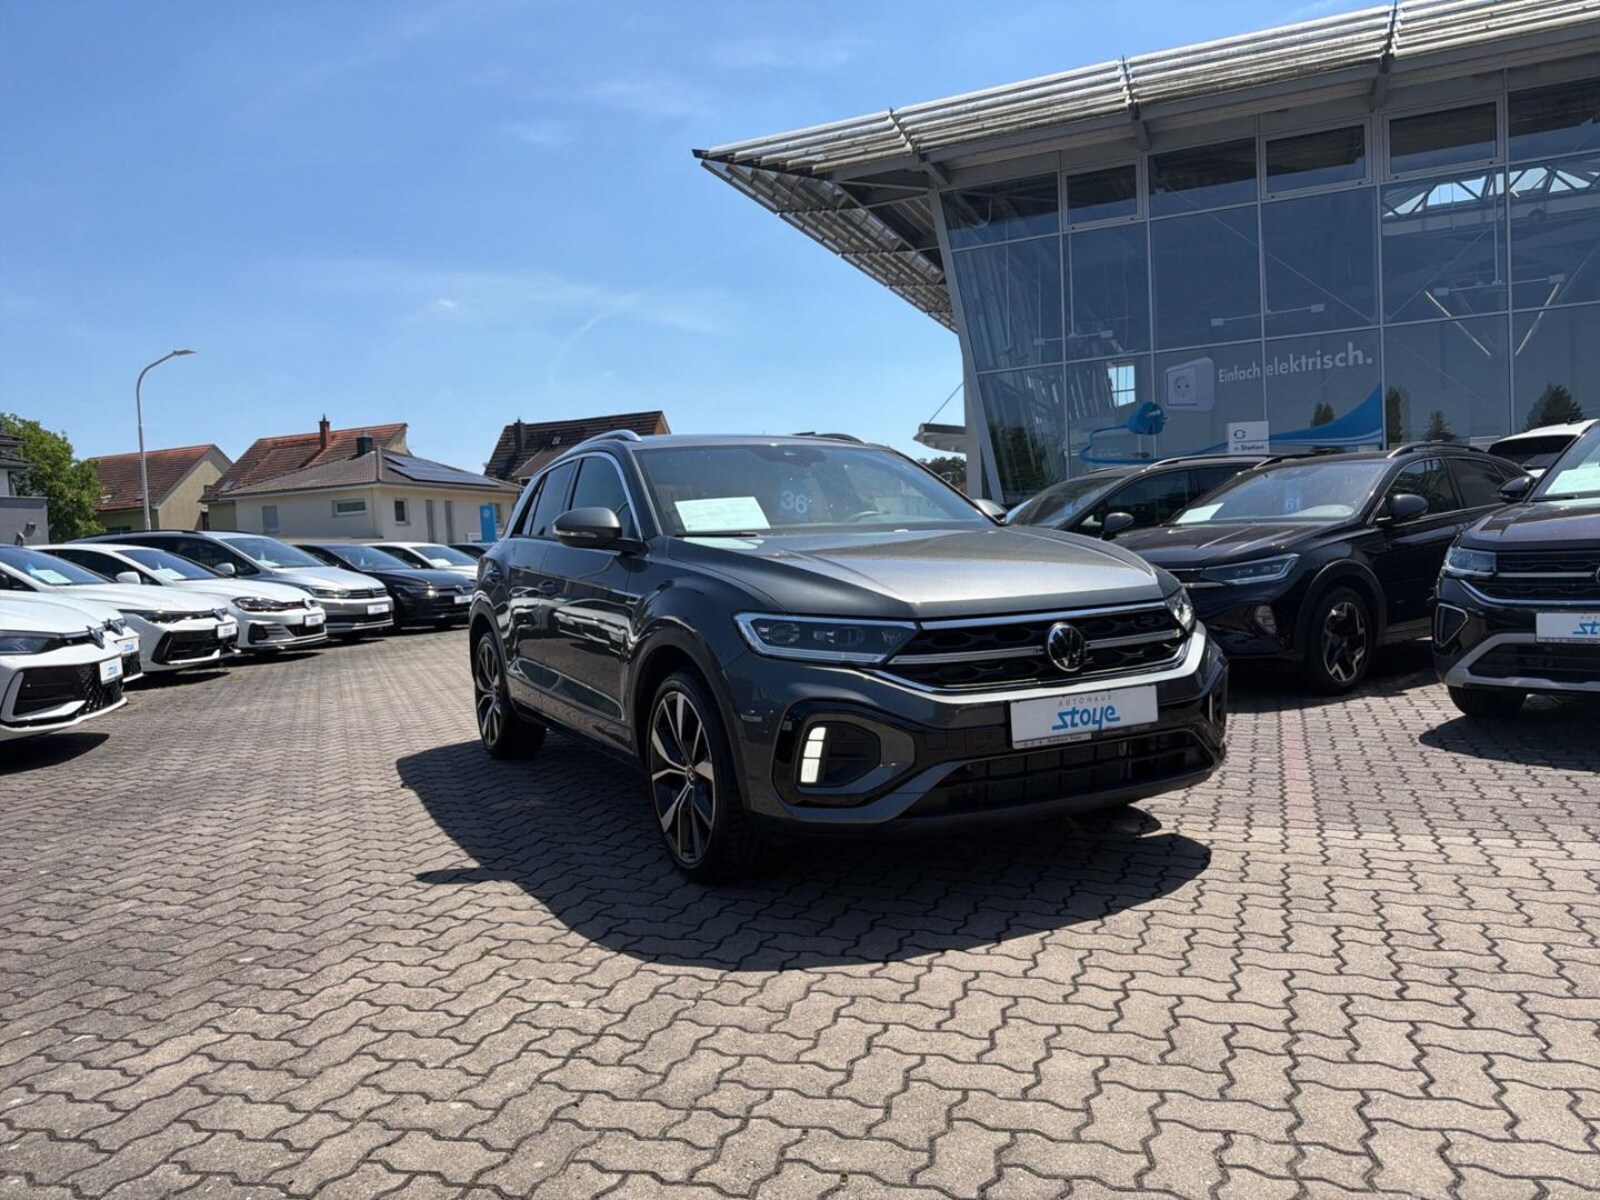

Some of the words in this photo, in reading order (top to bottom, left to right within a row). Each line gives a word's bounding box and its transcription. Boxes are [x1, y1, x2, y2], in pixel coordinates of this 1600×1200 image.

[1218, 361, 1261, 383] Einfach
[1266, 341, 1373, 377] elektrisch.
[781, 490, 808, 514] 36
[1058, 693, 1112, 707] AUTOHAUS
